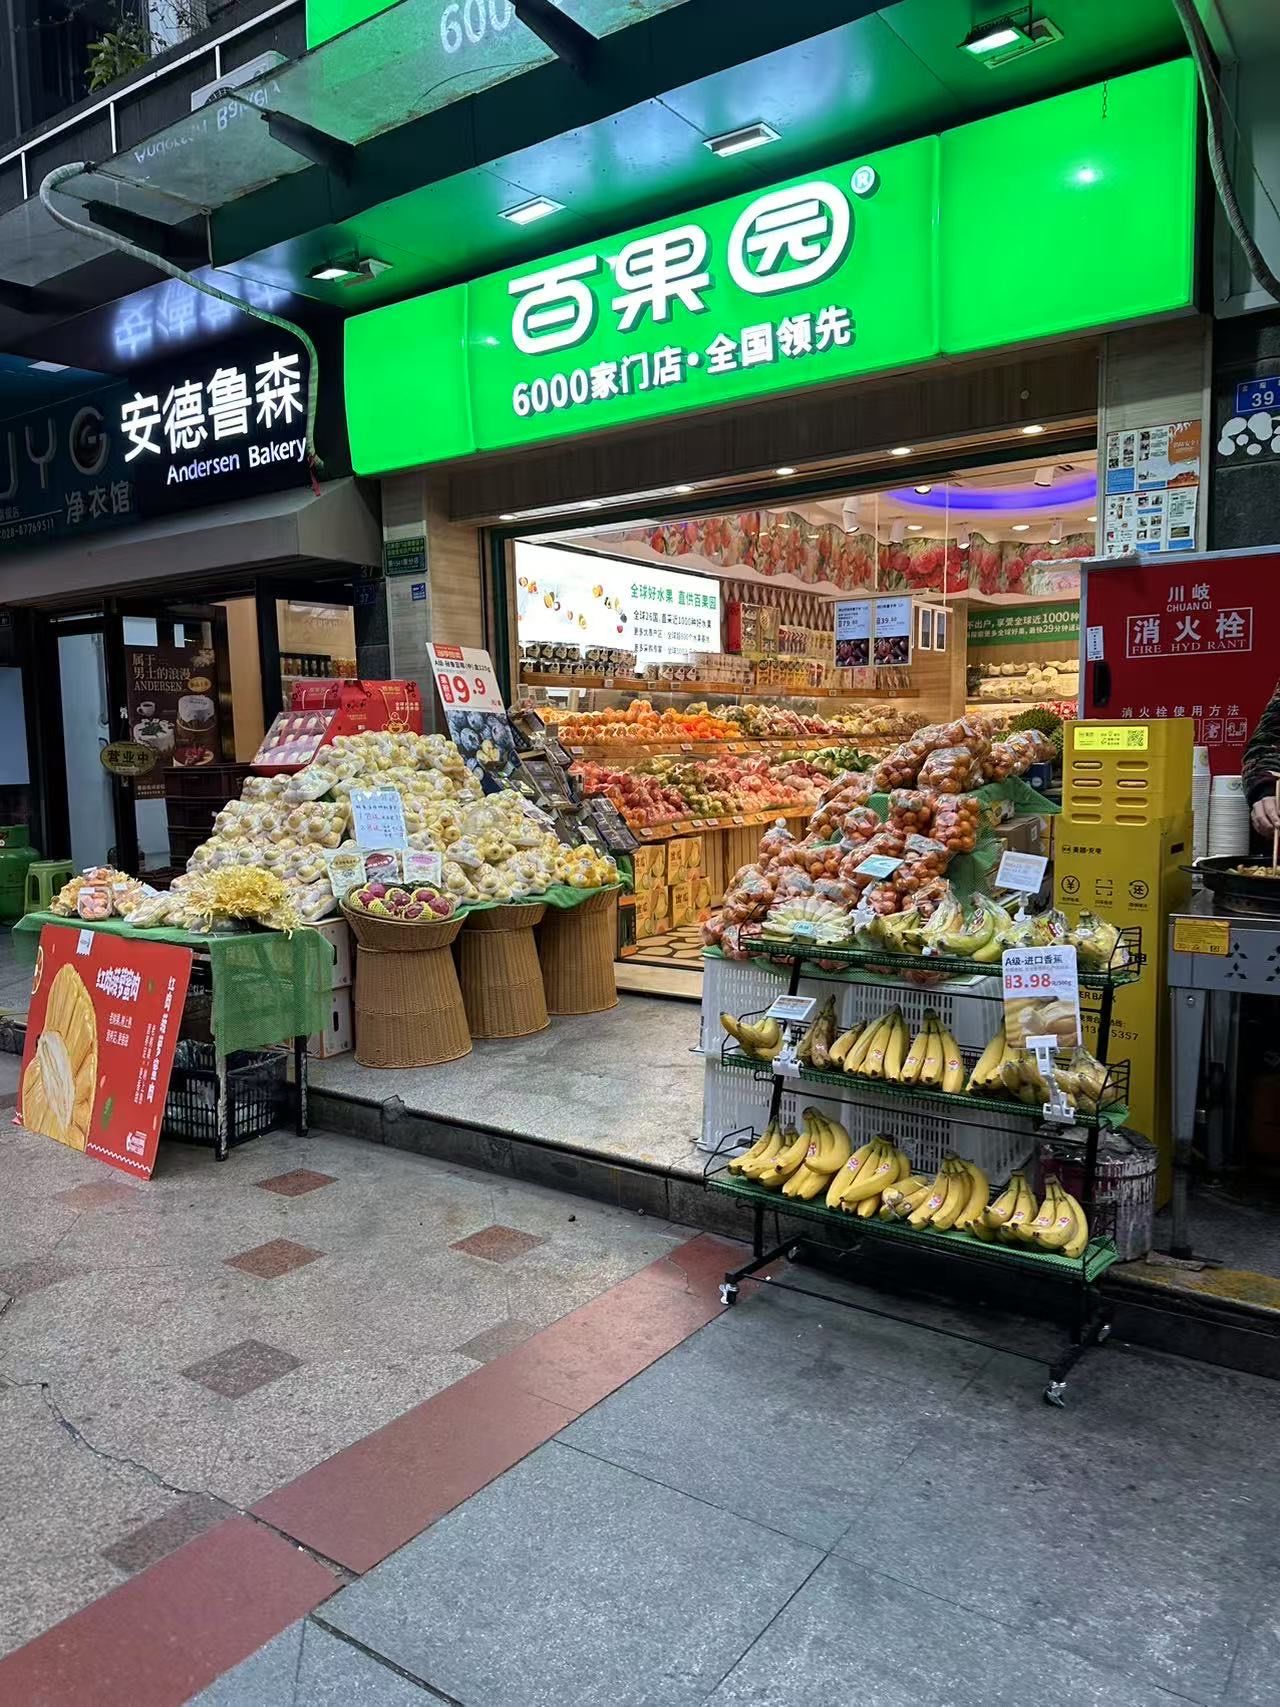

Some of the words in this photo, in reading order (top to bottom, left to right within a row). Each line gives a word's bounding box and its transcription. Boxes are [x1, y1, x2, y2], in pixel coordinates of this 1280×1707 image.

[508, 181, 850, 354] 百果园
[512, 305, 852, 417] 6000家门店·全国领先
[121, 351, 304, 463] 安德鲁森
[1251, 390, 1275, 407] 39
[166, 453, 241, 486] Andersen
[248, 437, 307, 469] Bakery
[64, 479, 131, 525] 净衣馆
[1168, 583, 1211, 603] 川岐
[1166, 603, 1200, 613] CHUAN
[1133, 612, 1246, 644] 消火栓
[1132, 644, 1162, 655] FIRE
[1171, 642, 1201, 652] HYD
[1207, 639, 1247, 650] RANT
[134, 680, 183, 692] ANDERSEN
[1121, 704, 1240, 718] 消火栓使用方法
[107, 750, 149, 765] 营业中
[1005, 954, 1063, 967] A级-进口香蕉
[1013, 973, 1051, 988] 3.98
